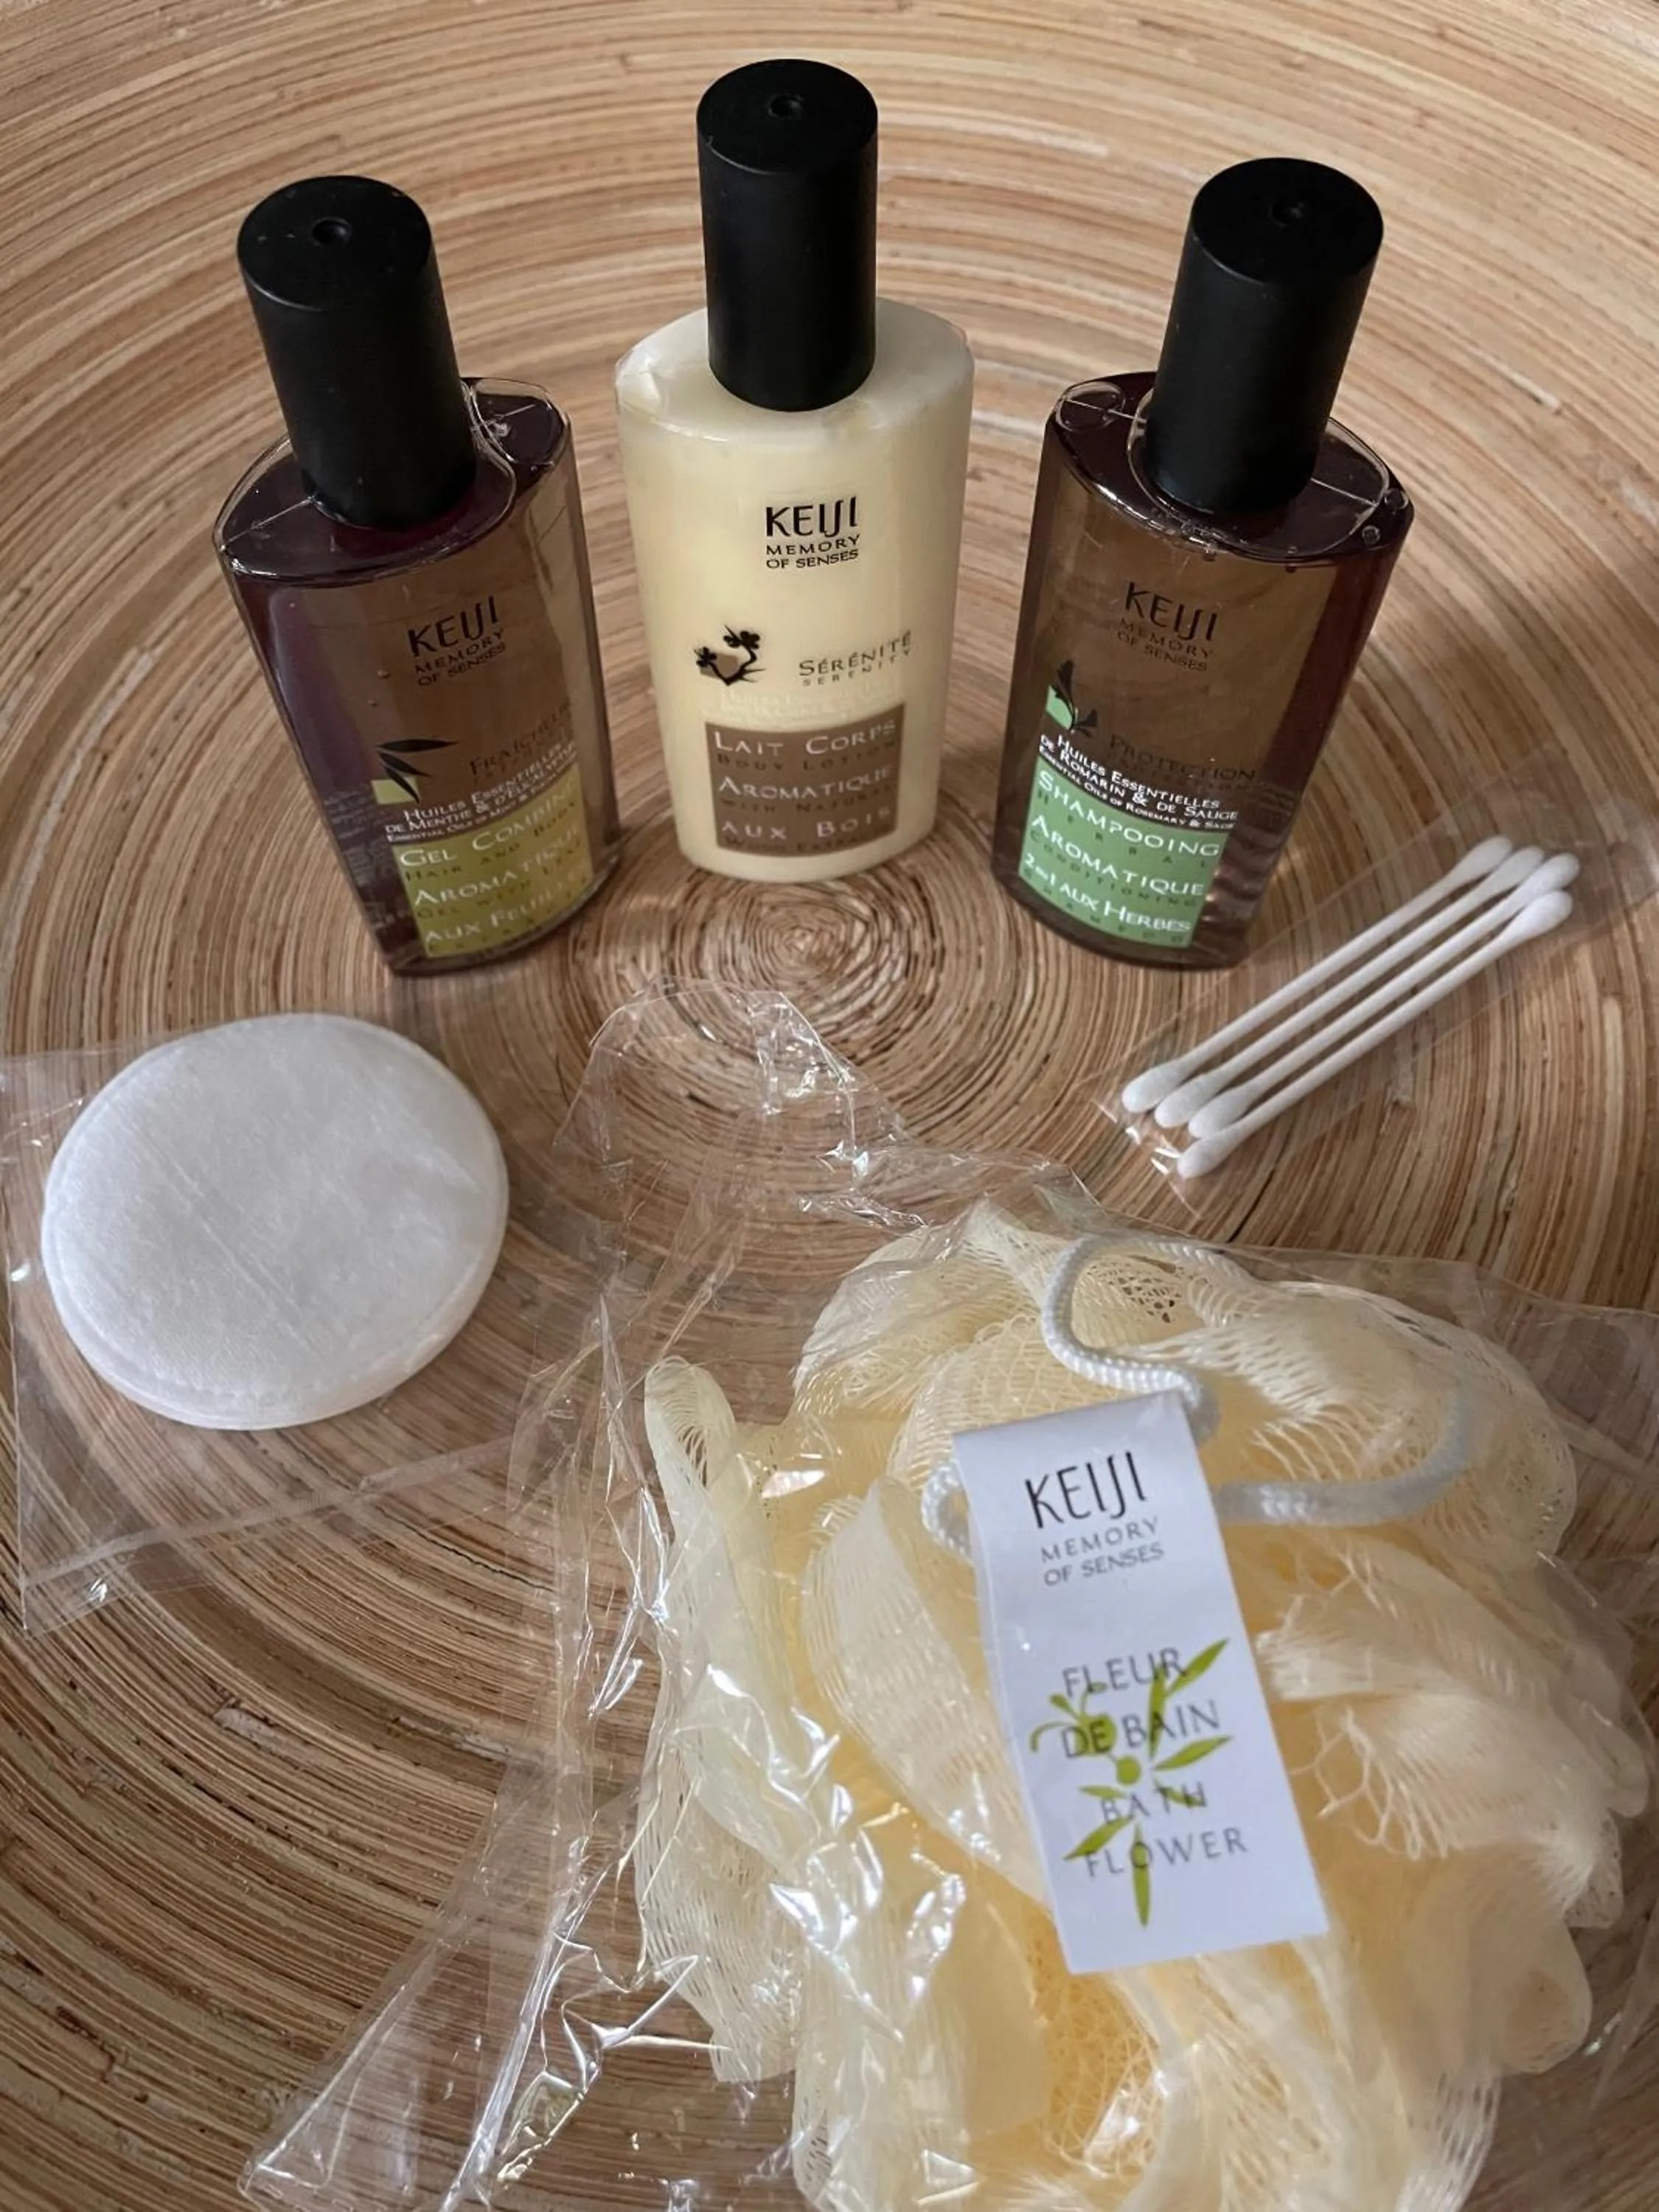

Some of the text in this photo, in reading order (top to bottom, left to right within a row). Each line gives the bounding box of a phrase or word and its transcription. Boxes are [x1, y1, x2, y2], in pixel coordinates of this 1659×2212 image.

[765, 496, 858, 538] KEIJI
[766, 534, 860, 555] MEMORY
[766, 549, 859, 569] OF SENSES
[408, 595, 498, 657] KEIJI
[1125, 581, 1217, 641] KEIJI
[414, 627, 504, 674] MEMORY
[799, 630, 911, 676] SÉRÉNITÉ
[1117, 630, 1208, 672] OF SENSES
[1120, 617, 1214, 658] MEMORY
[418, 672, 440, 686] OF
[714, 720, 896, 756] LAIT CORPS
[719, 764, 894, 799] AROMATIQUE
[1057, 734, 1106, 777] HUILES
[1111, 771, 1221, 809] ESSENTIELLES
[1060, 749, 1126, 799] ROMARIN
[1157, 802, 1176, 813] DE
[1183, 807, 1239, 821] SAUGE
[404, 799, 465, 822] HUILES
[722, 820, 787, 840] AUX
[1038, 770, 1221, 858] SHAMPOOING
[400, 849, 459, 867] GEL
[1031, 814, 1205, 897] AROMATIQUE
[1059, 883, 1101, 911] AUX
[1104, 900, 1192, 933] HERBES
[425, 925, 482, 943] AUX
[1025, 1450, 1147, 1529] KEIJI
[1041, 1517, 1159, 1563] MEMORY
[1044, 1543, 1165, 1587] OF SENSES
[1062, 1647, 1189, 1696] FLEUR
[1062, 1699, 1221, 1759] DE BAIN
[1099, 1780, 1207, 1824] BATH
[1085, 1827, 1248, 1878] FLOWER
